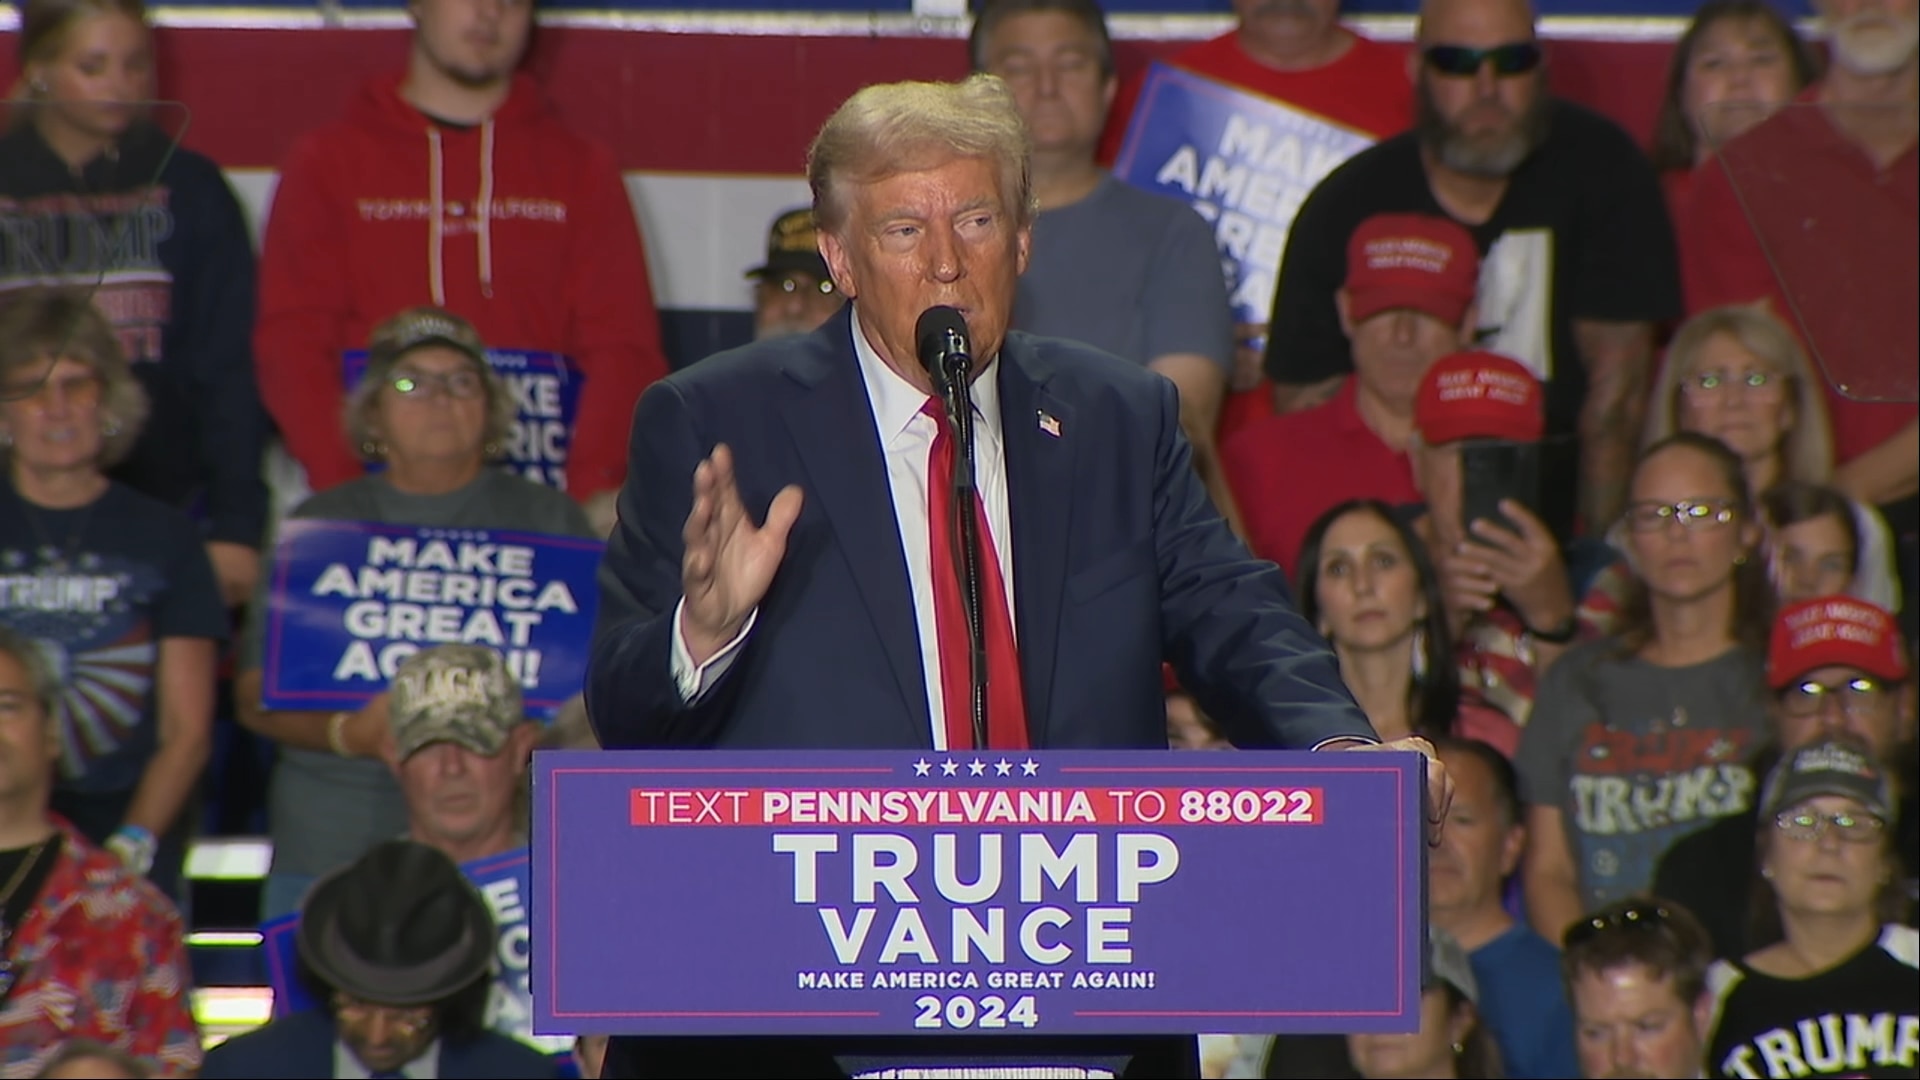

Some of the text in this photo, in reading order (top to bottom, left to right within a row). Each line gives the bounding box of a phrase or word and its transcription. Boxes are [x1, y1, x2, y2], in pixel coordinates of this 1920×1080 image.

[367, 536, 535, 577] MAKE
[311, 563, 579, 614] AMERICA
[343, 600, 542, 647] GREAT
[640, 790, 1313, 823] TEXT PENNSYLVANIA TO 88022
[1569, 763, 1757, 836] TRUMP
[773, 832, 1180, 904] TRUMP
[818, 906, 1132, 965] VANCE
[798, 972, 1155, 989] MAKE AMERICA GREAT AGAIN!
[914, 996, 1039, 1029] 2024
